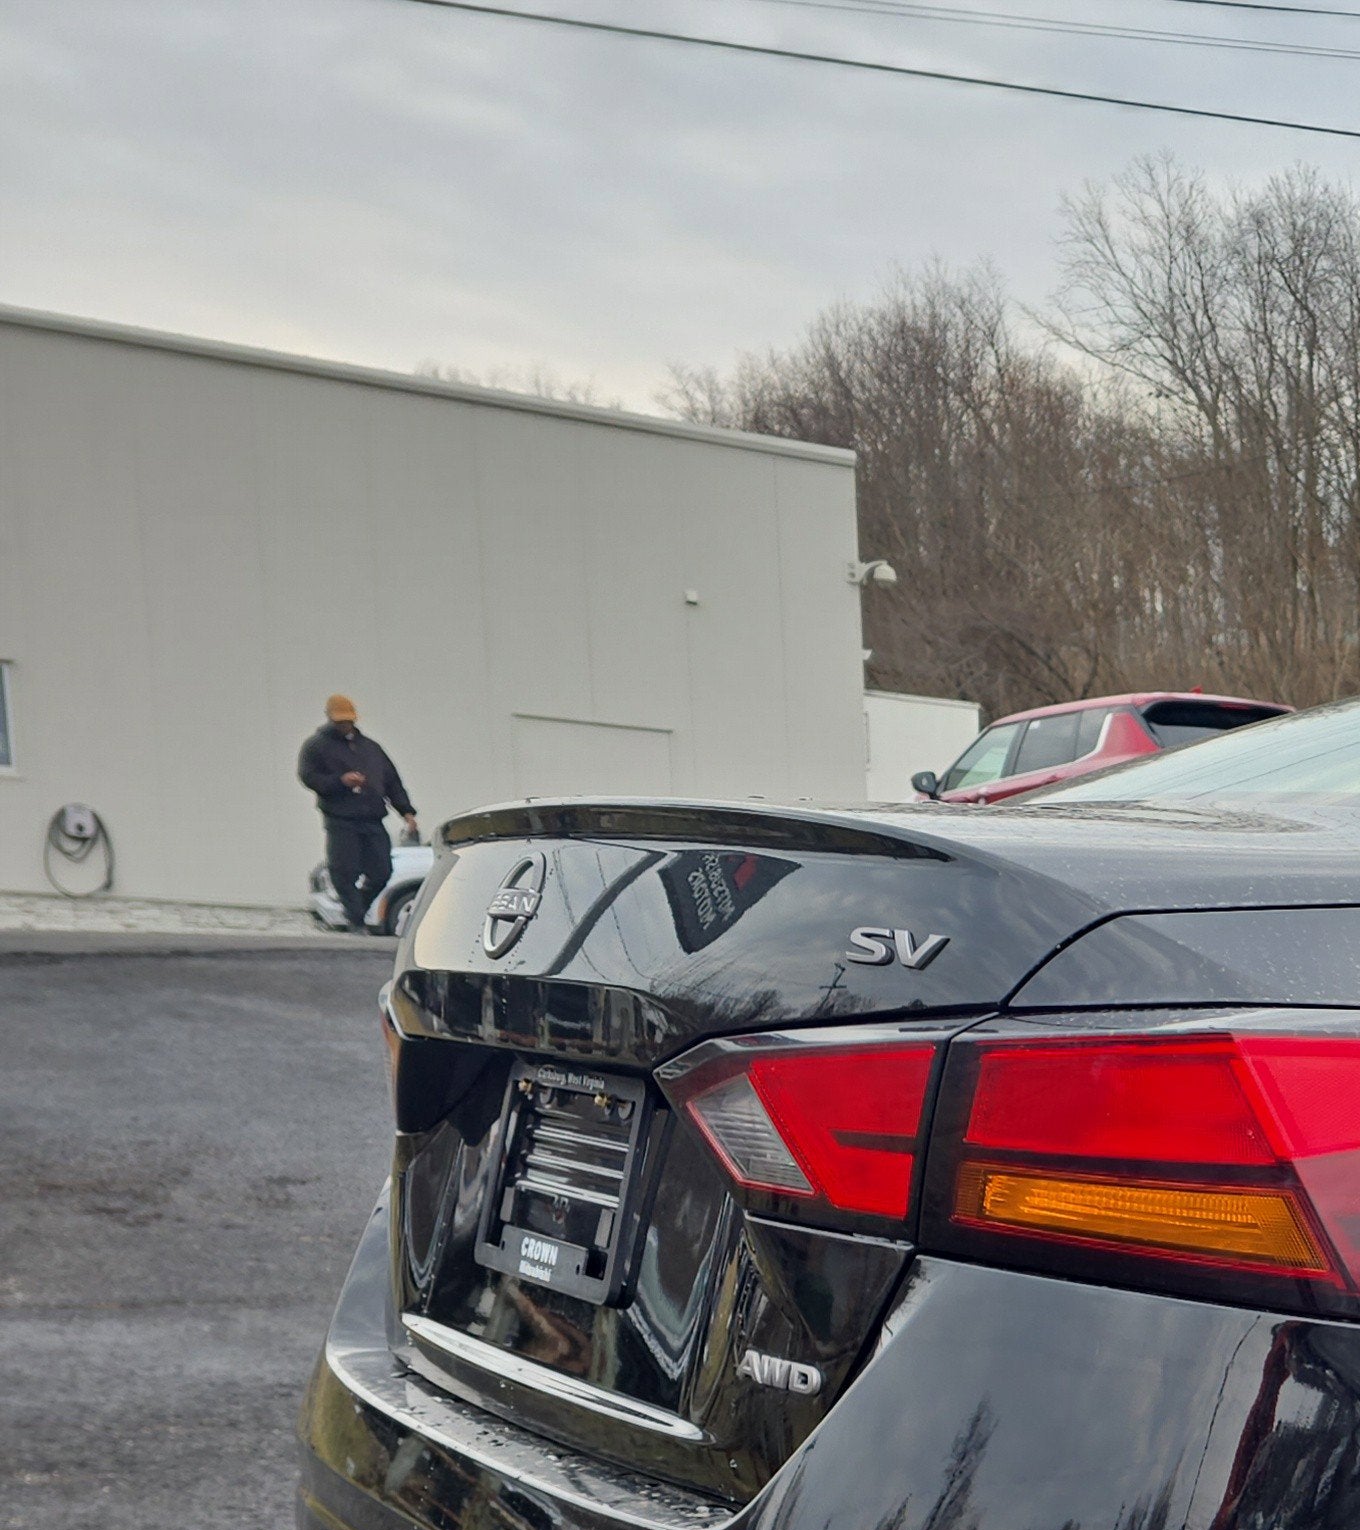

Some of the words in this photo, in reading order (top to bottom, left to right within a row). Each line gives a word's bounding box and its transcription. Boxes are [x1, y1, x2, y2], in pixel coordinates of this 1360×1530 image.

[845, 926, 951, 971] SV
[520, 1236, 559, 1267] CROWN
[736, 1348, 823, 1395] AWD
